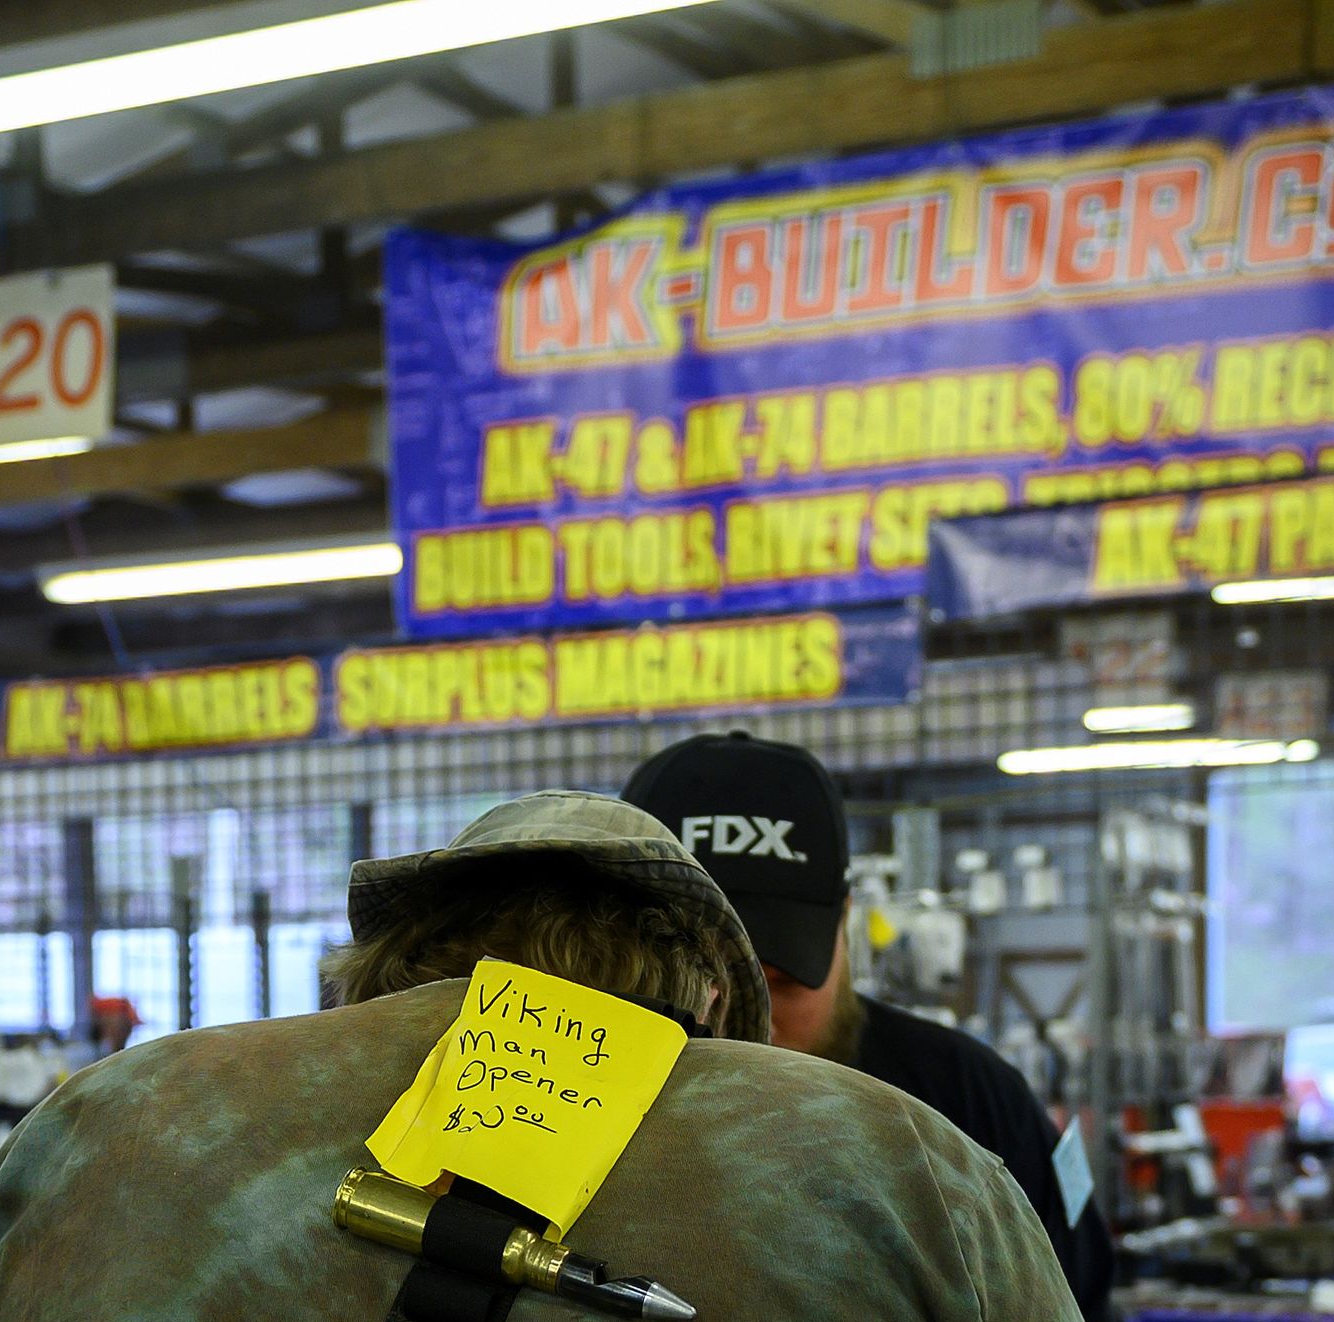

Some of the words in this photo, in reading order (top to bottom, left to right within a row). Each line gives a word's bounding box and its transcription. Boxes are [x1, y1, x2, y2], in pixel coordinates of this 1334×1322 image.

[480, 416, 636, 508] AK-47
[634, 417, 680, 497] &
[680, 388, 817, 490] AK-74
[819, 363, 1065, 471] BARRELS,
[1072, 346, 1206, 450] 80%
[413, 521, 555, 614] BUILD
[724, 489, 869, 586] RIVET
[1094, 496, 1267, 592] AK-47
[6, 679, 124, 757] AK-74
[121, 656, 320, 750] BARRELS
[336, 637, 551, 732] SURPLUS
[552, 611, 843, 717] MAGAZINES
[459, 1029, 547, 1065] Man
[479, 979, 610, 1066] Viking
[456, 1060, 603, 1109] Opener
